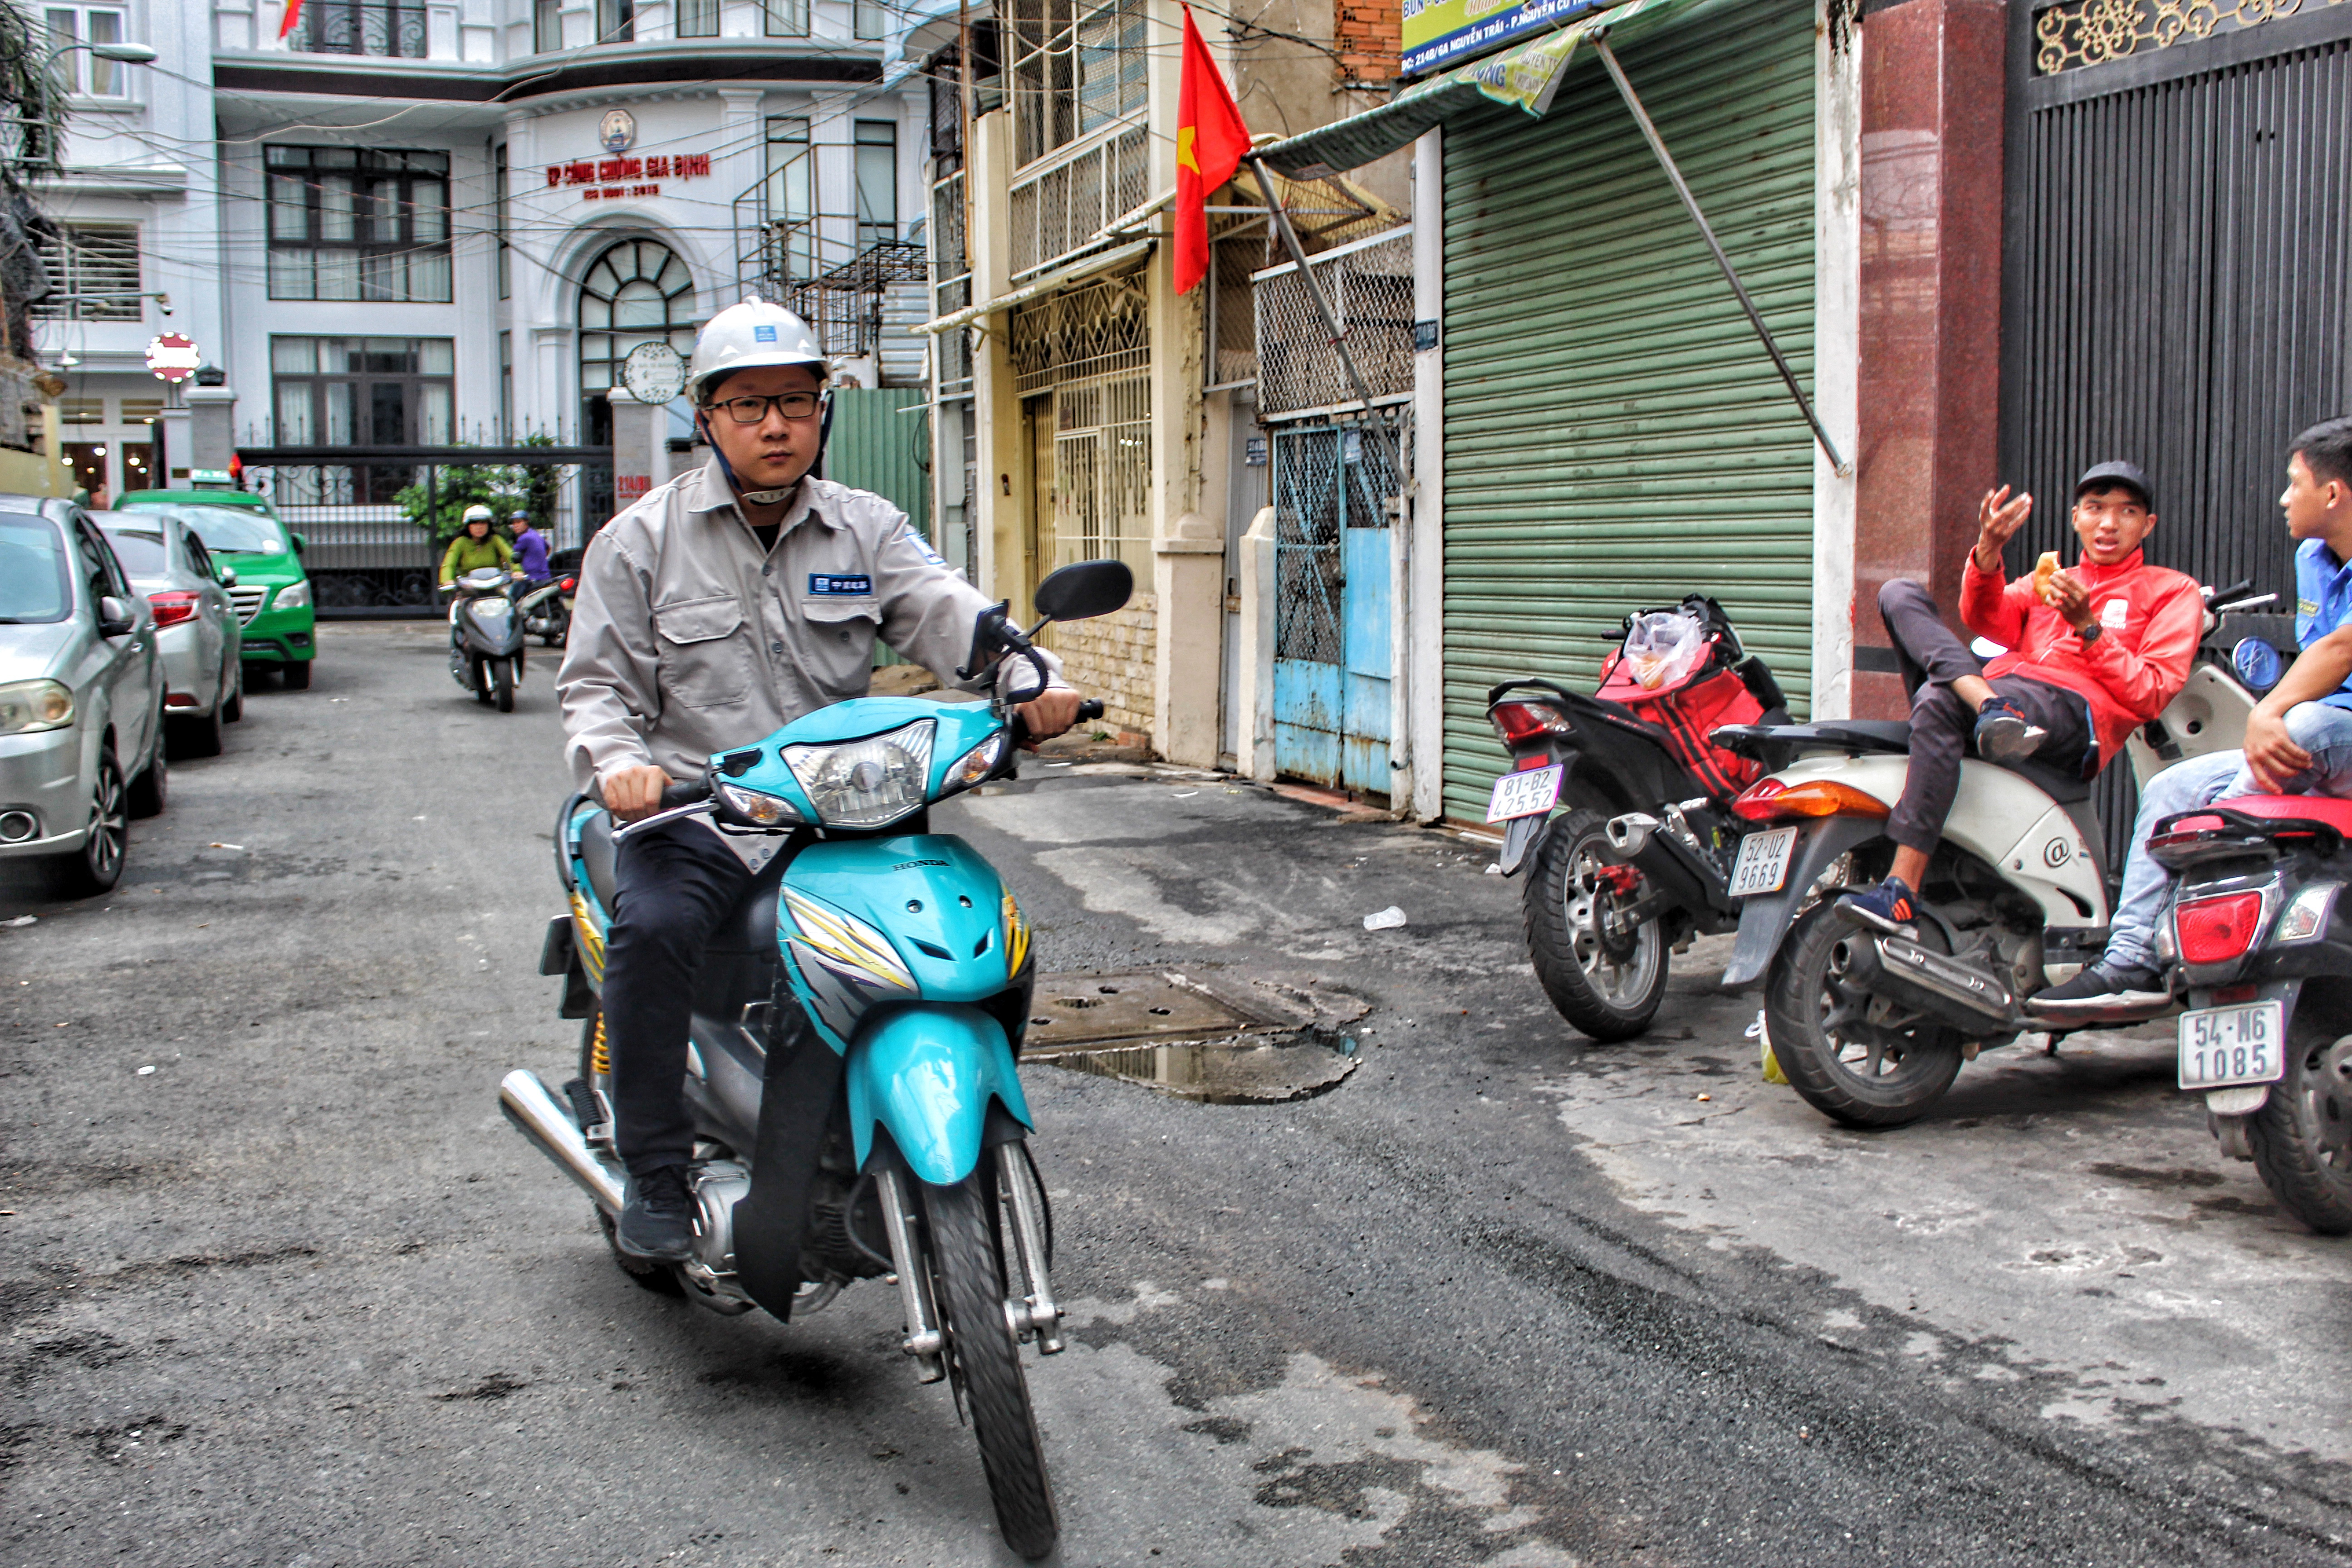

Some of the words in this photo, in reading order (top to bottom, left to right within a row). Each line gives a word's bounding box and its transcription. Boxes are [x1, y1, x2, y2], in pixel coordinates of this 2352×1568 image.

[1415, 42, 1449, 65] 214B/6A
[1504, 771, 1550, 797] 81-B2
[1494, 789, 1553, 817] 425.52
[892, 859, 951, 871] HONDA
[1739, 862, 1779, 889] 9669
[2195, 1044, 2265, 1081] 1085
